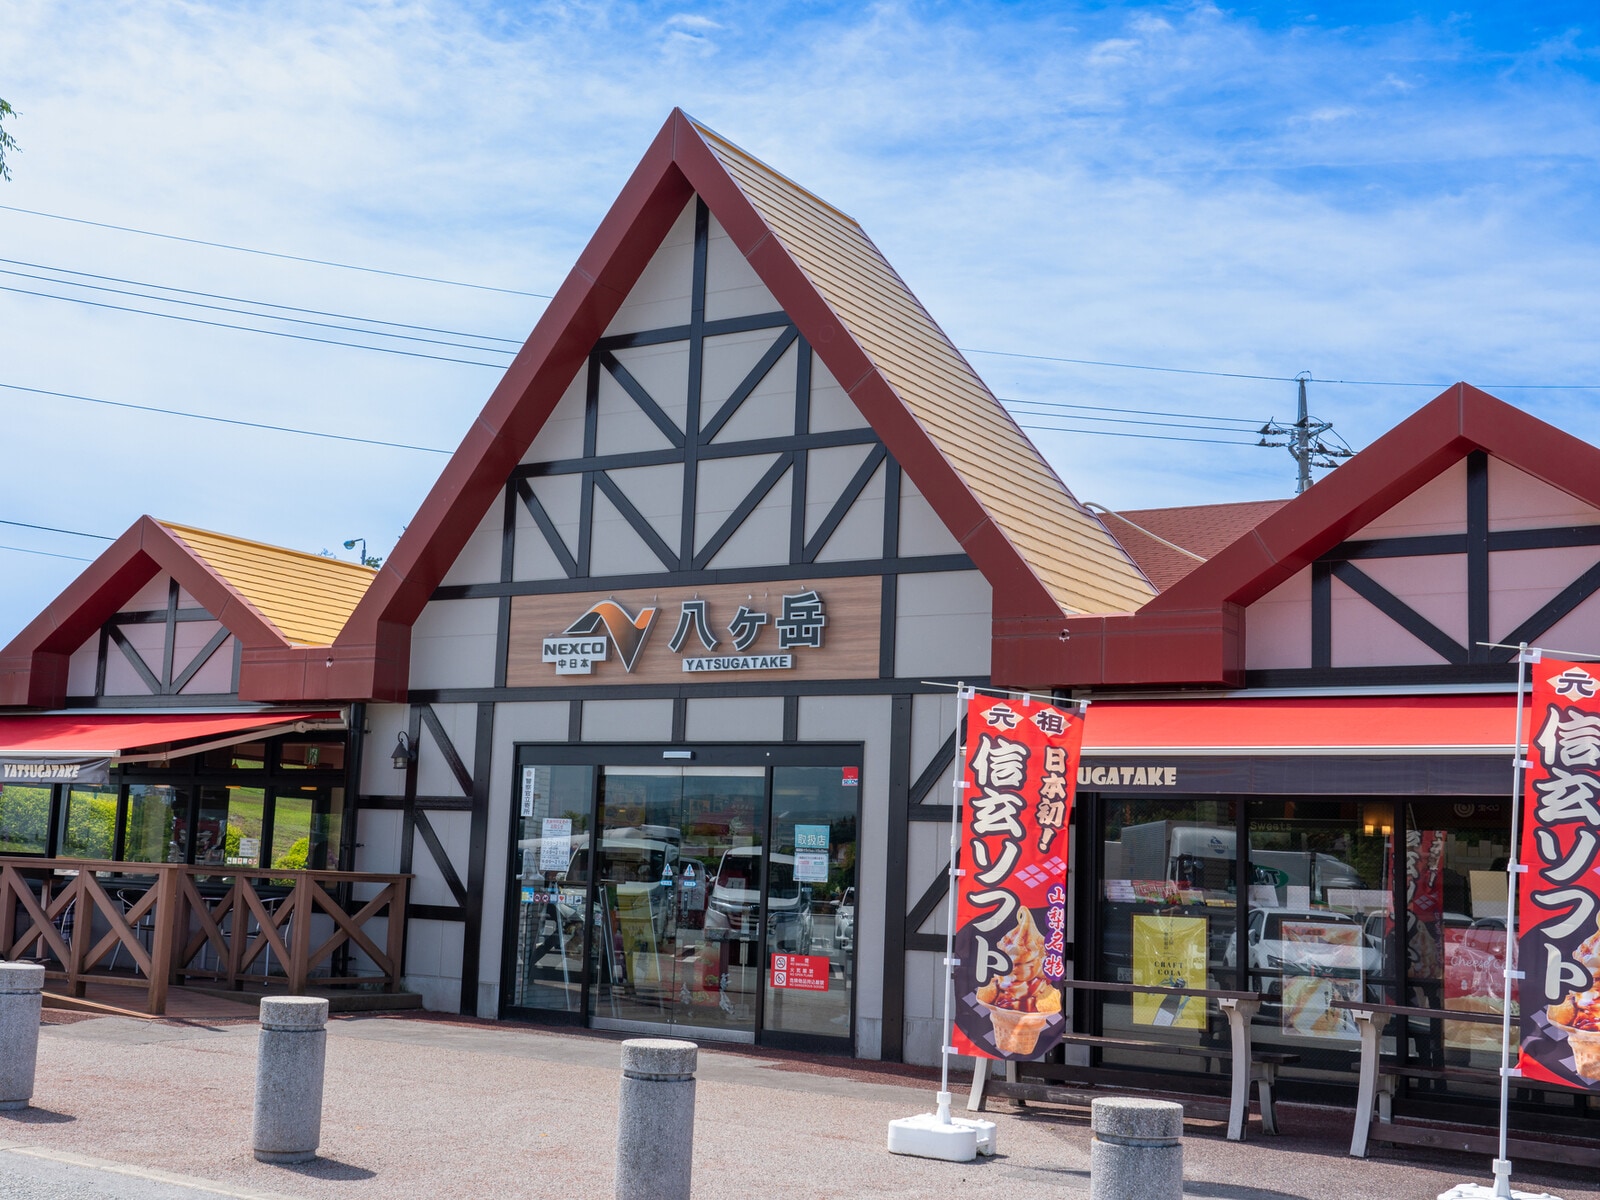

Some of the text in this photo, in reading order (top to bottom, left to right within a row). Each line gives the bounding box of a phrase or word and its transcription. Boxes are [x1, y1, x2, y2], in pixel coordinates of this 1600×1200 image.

[543, 642, 605, 656] NEXCO
[557, 658, 590, 669] 中日本
[685, 655, 789, 671] YATSUGATAKE
[3, 763, 82, 778] YATSUGATAKE
[1249, 820, 1293, 831] Sweets
[797, 833, 827, 846] 取扱店
[968, 734, 1028, 984] 信玄ソフト
[1535, 706, 1600, 1001] 信玄ソフト
[1043, 887, 1066, 977] 山梨名物
[1153, 960, 1184, 969] CRAFT
[1451, 955, 1490, 968] Cheese
[1157, 968, 1182, 977] COLA
